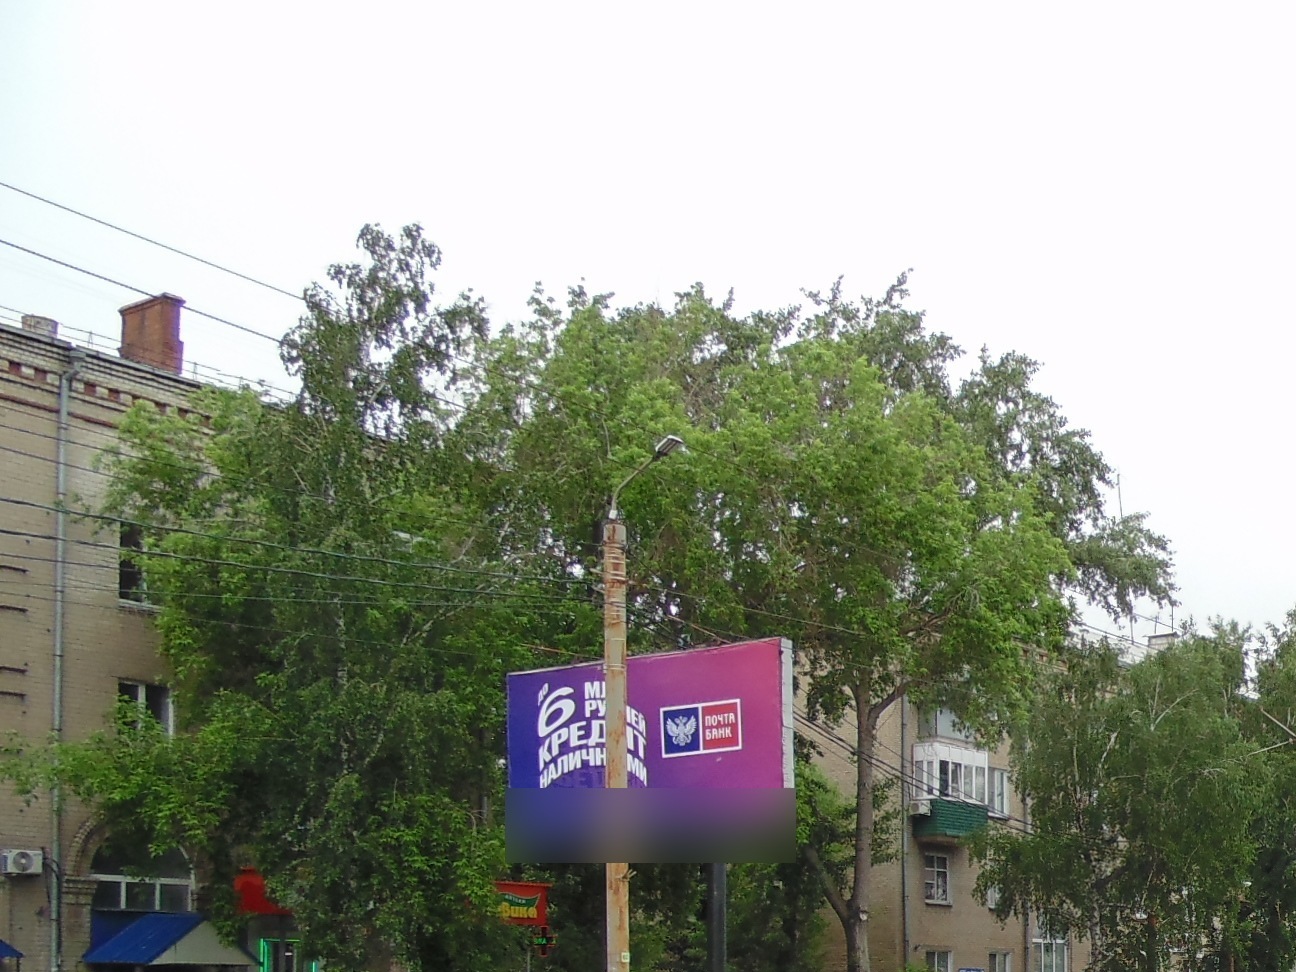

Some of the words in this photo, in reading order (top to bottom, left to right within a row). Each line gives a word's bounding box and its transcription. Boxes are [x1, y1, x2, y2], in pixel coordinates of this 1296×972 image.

[537, 686, 576, 738] 6
[585, 699, 646, 738] РУЕЙ
[704, 712, 736, 727] ПОЧТА
[705, 726, 732, 741] БАНК
[539, 747, 648, 789] НАЛИЧНМИ
